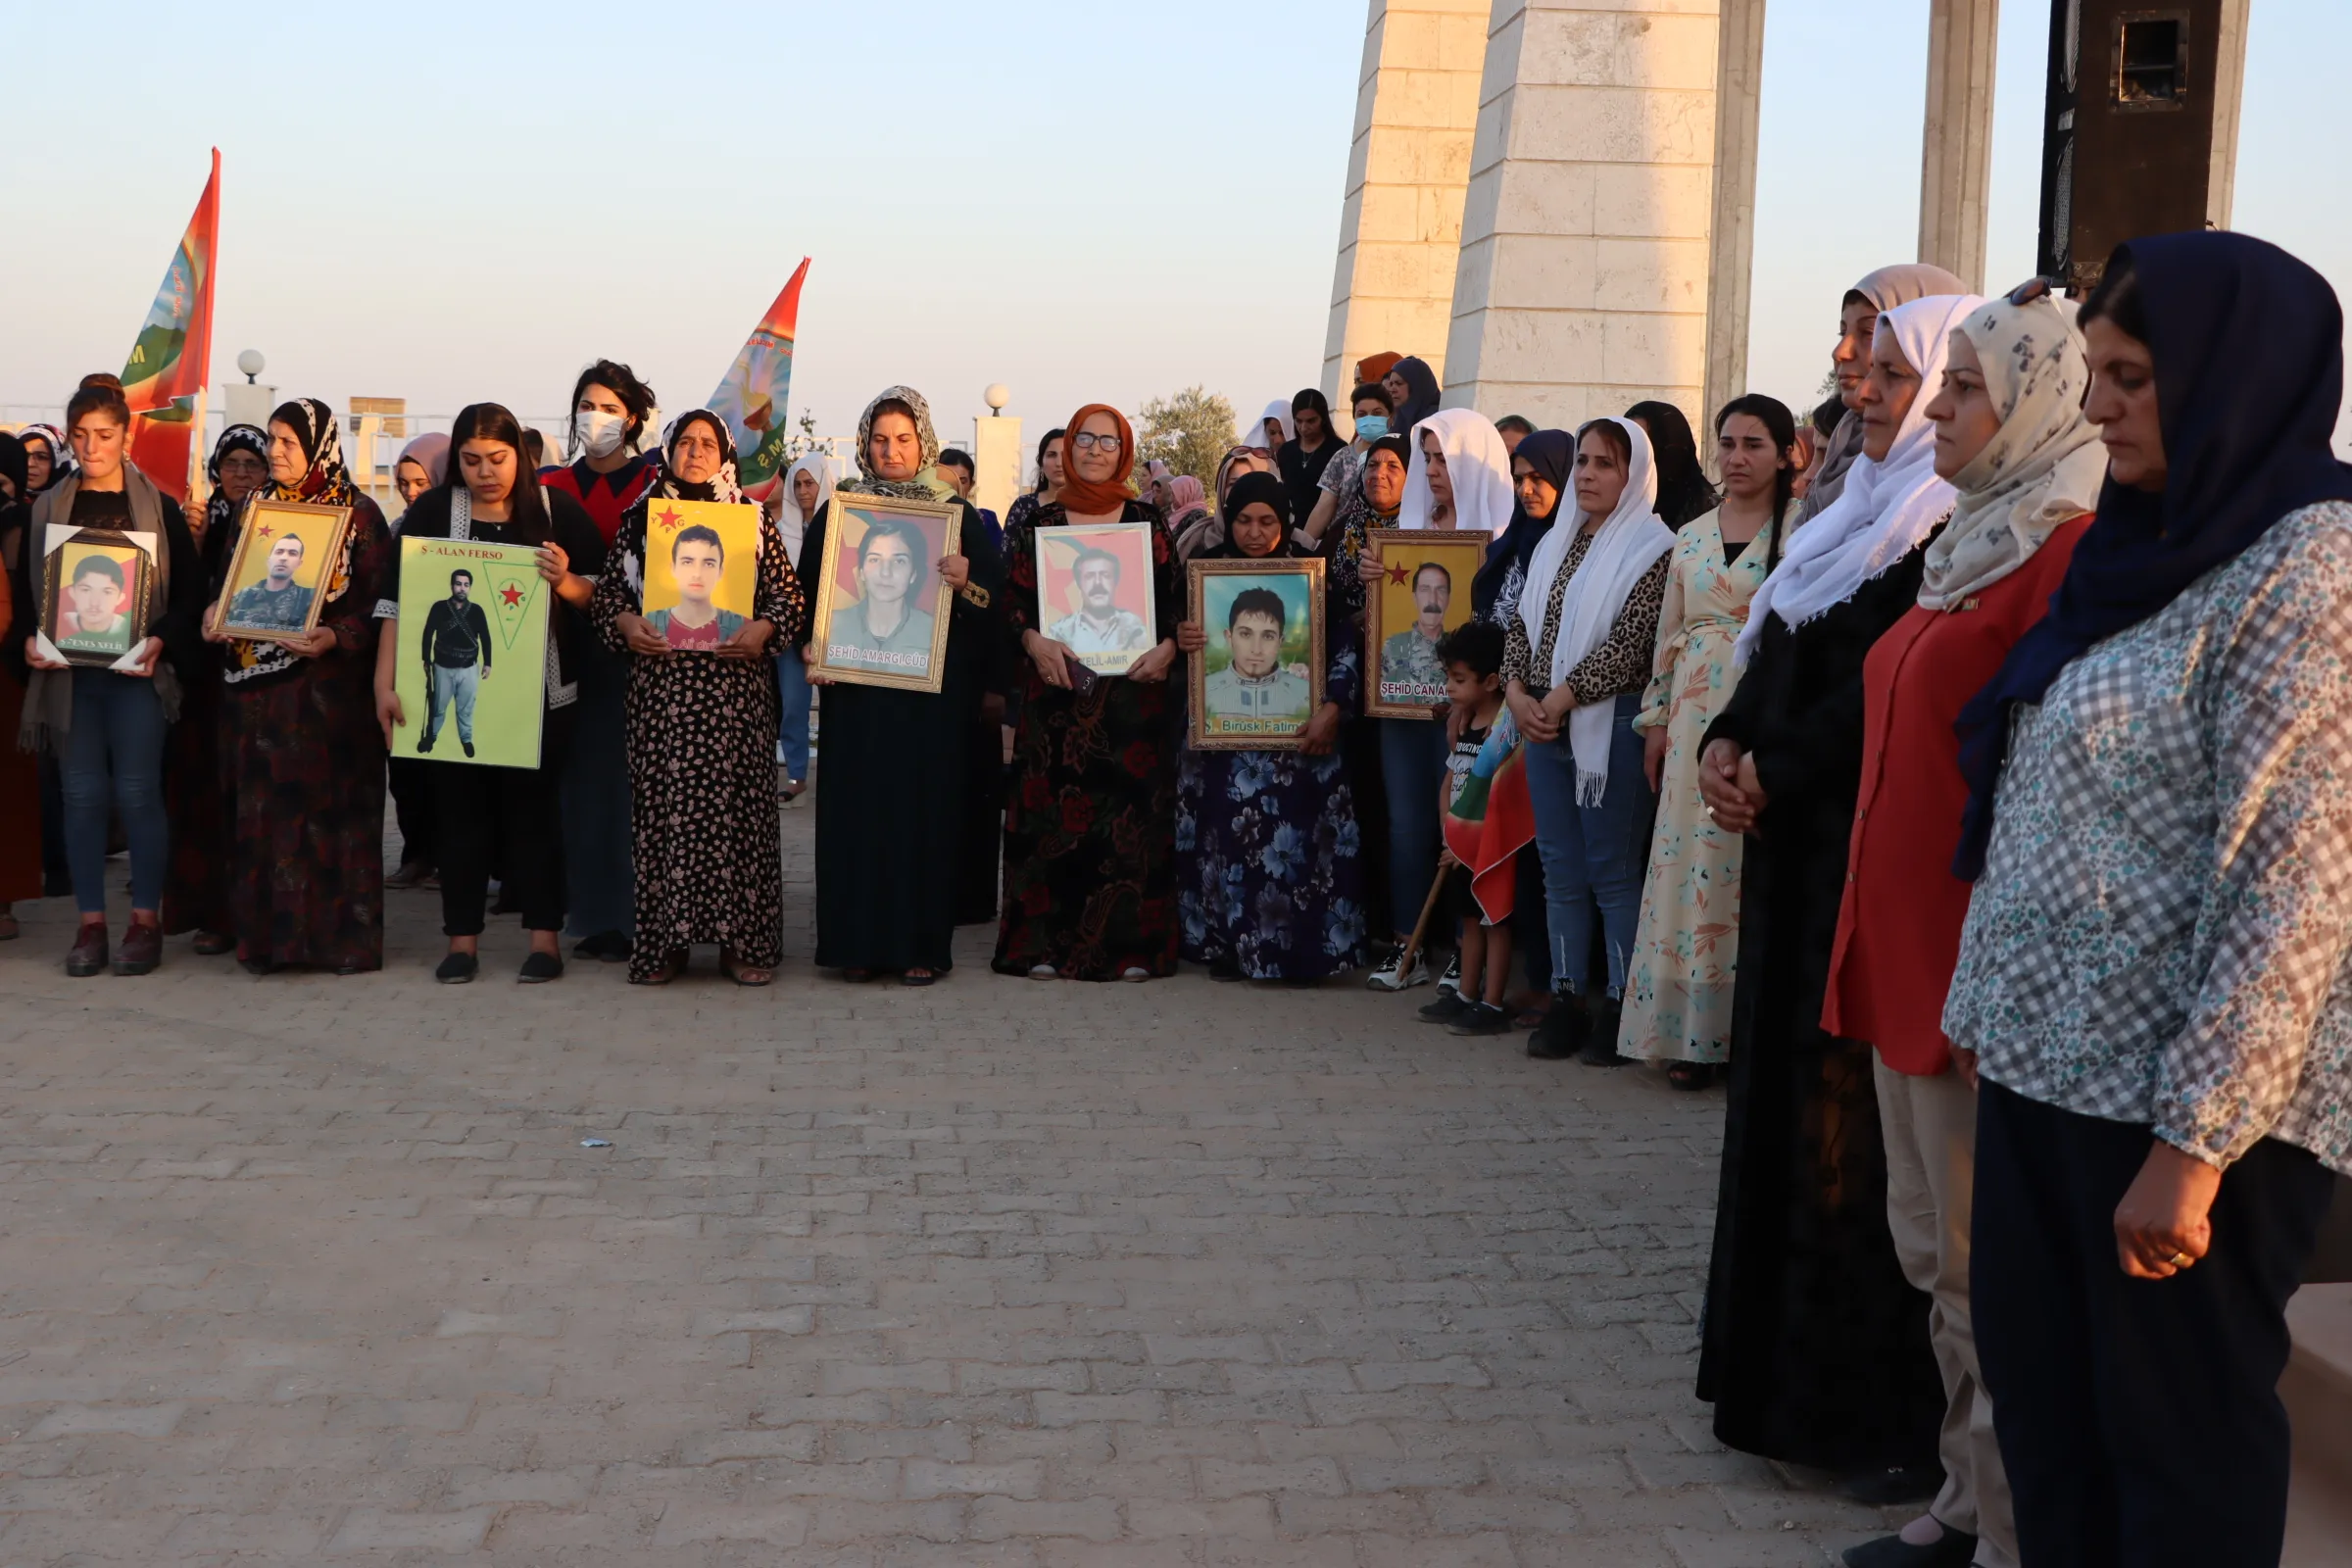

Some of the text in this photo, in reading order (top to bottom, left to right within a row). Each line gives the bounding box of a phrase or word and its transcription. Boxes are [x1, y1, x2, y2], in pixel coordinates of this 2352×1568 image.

[436, 547, 466, 557] ALAN
[468, 549, 504, 560] FERSO
[1414, 683, 1436, 696] CAN
[1264, 718, 1305, 732] Fatim
